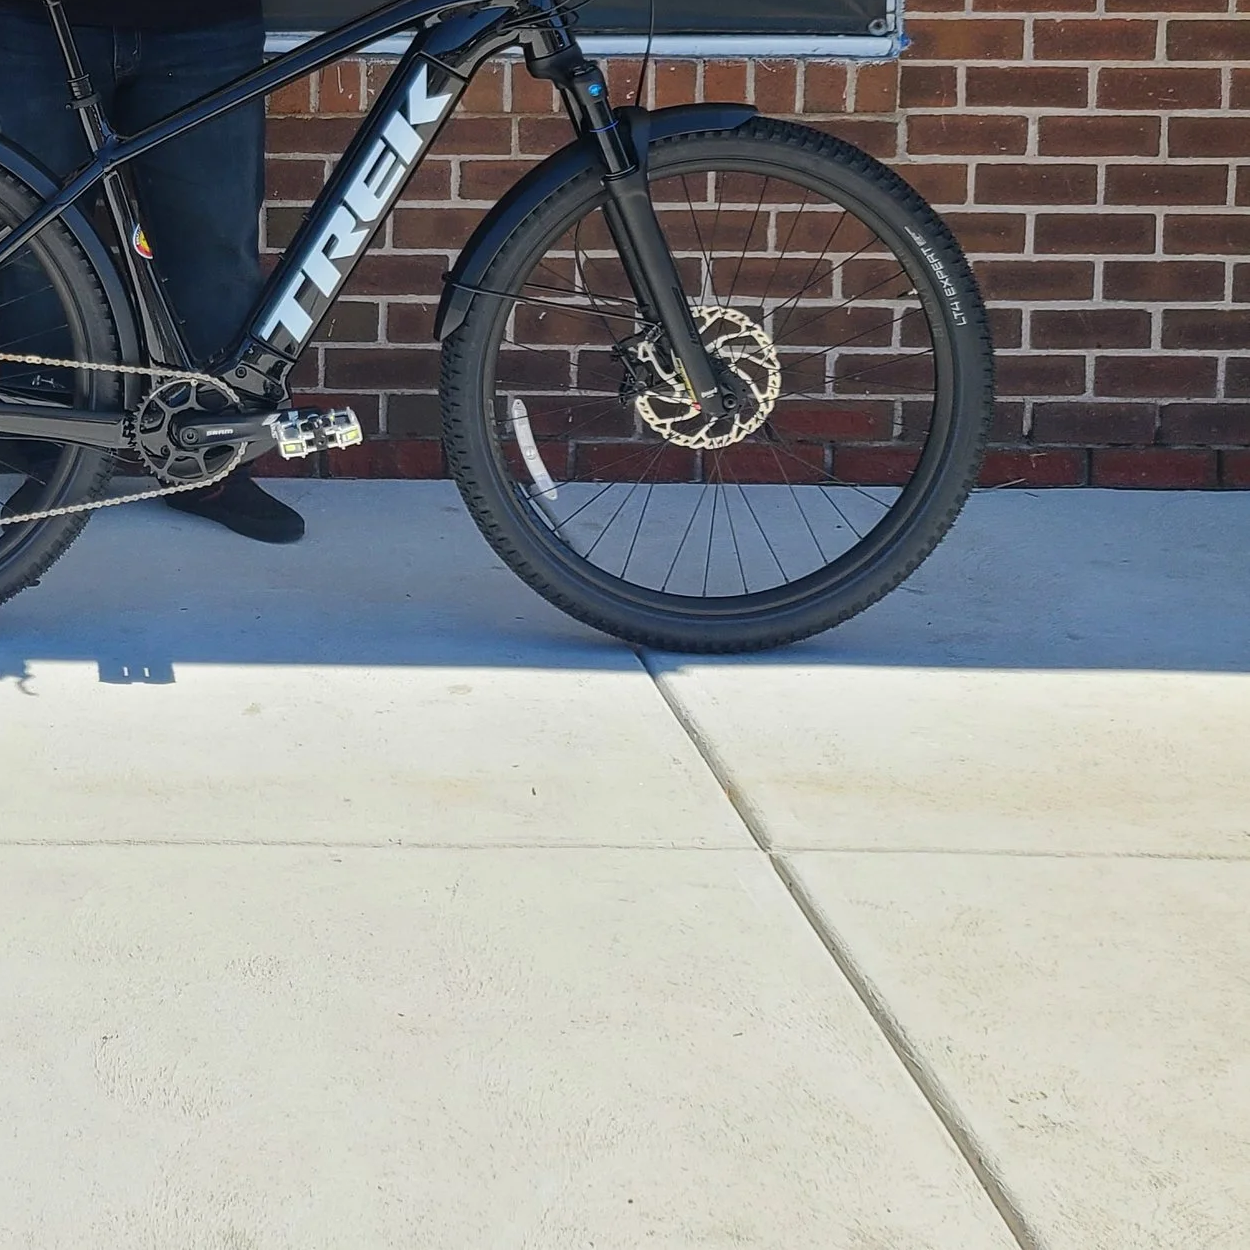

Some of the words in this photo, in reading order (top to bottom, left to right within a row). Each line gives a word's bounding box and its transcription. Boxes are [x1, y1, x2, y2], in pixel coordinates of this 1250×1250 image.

[261, 63, 453, 343] TREK
[921, 247, 957, 297] EXPERT
[950, 301, 967, 326] LT4
